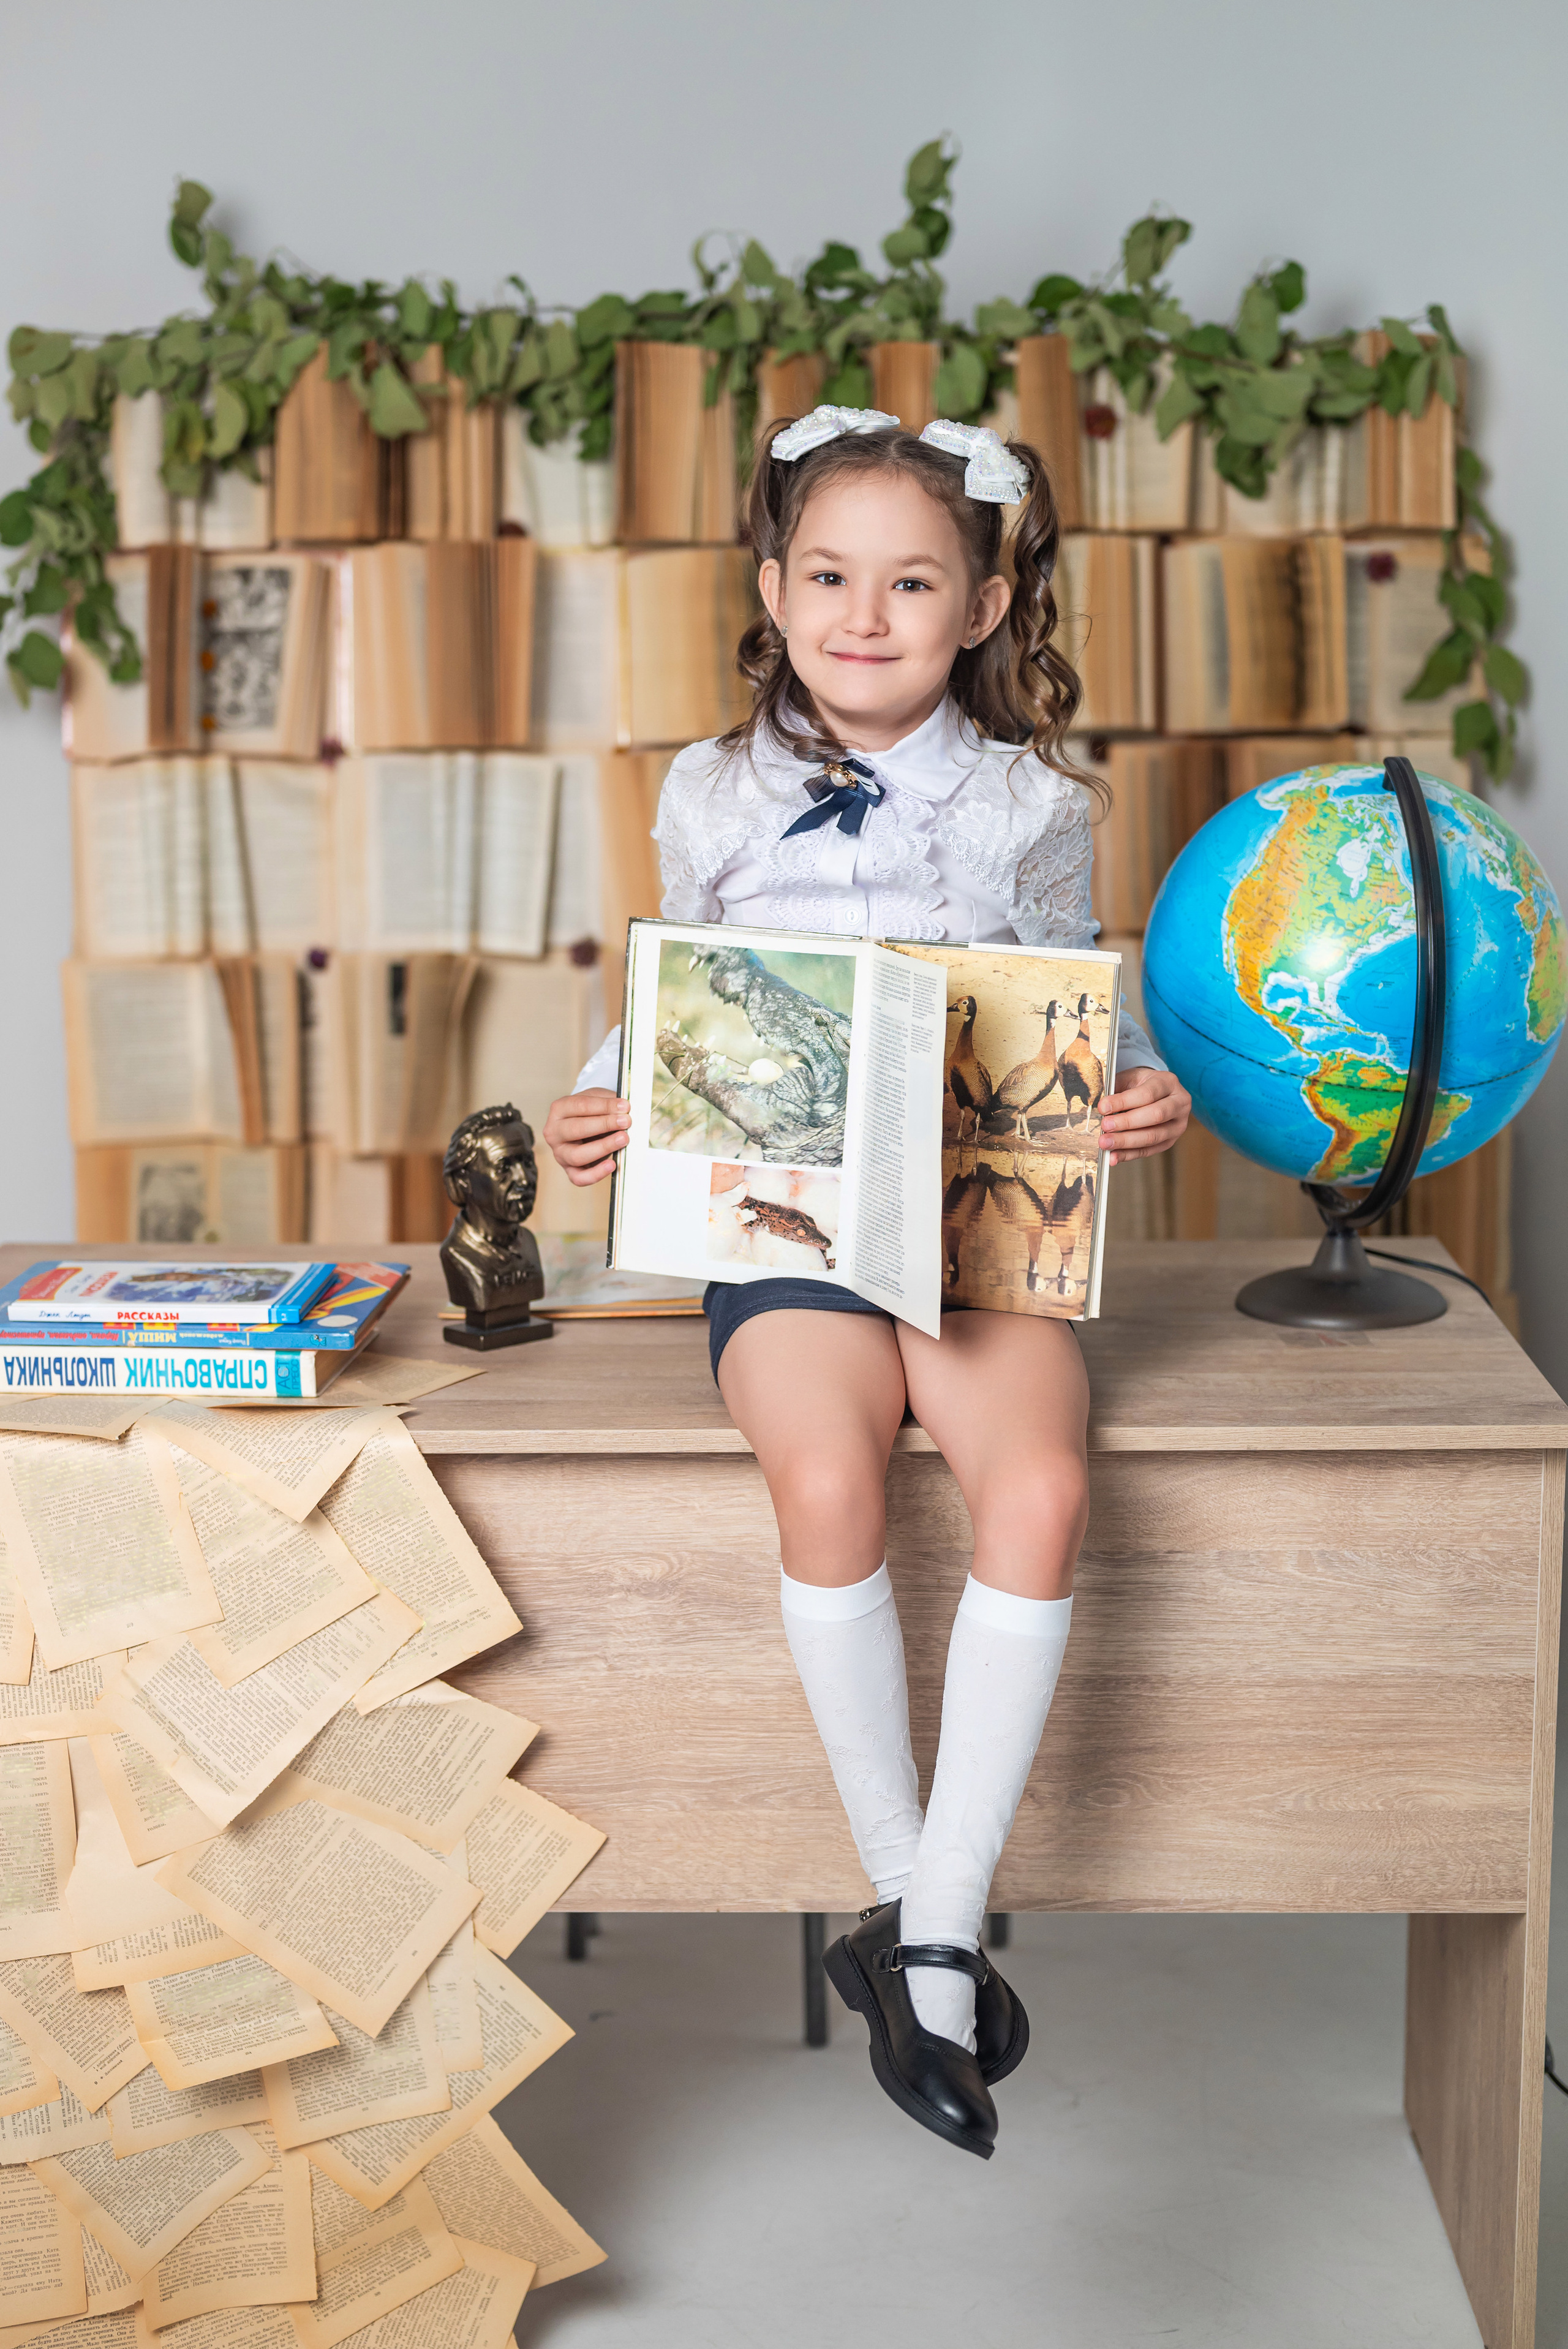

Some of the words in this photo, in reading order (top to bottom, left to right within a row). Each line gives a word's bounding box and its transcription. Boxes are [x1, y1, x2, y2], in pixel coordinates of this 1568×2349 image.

[118, 1311, 179, 1321] РАССКАЗЫ
[127, 1332, 177, 1343] МИША
[4, 1355, 116, 1387] ШКОЛЬНИКА
[125, 1358, 268, 1389] СПРАВОЧНИК
[276, 1358, 290, 1390] АСТ
[290, 1359, 300, 1390] ПРЕСС
